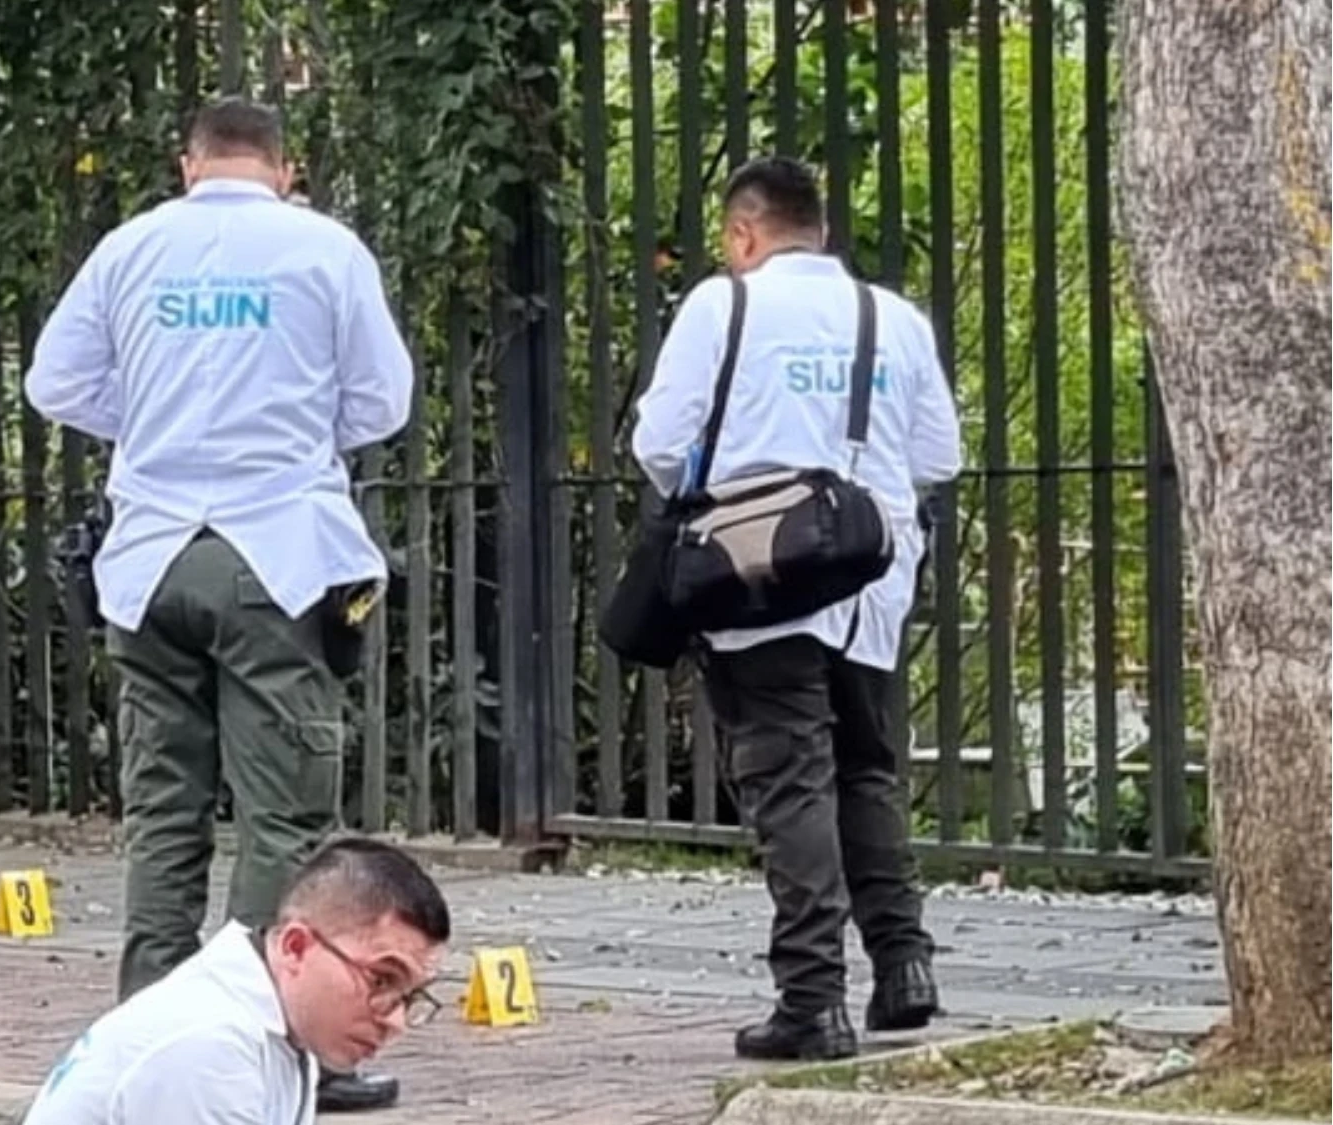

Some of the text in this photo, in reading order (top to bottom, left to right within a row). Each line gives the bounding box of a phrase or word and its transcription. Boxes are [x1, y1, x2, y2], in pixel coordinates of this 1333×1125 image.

[157, 292, 271, 329] SIJIN
[786, 359, 888, 395] SIJN
[15, 880, 36, 926] 3
[498, 960, 524, 1013] 2
